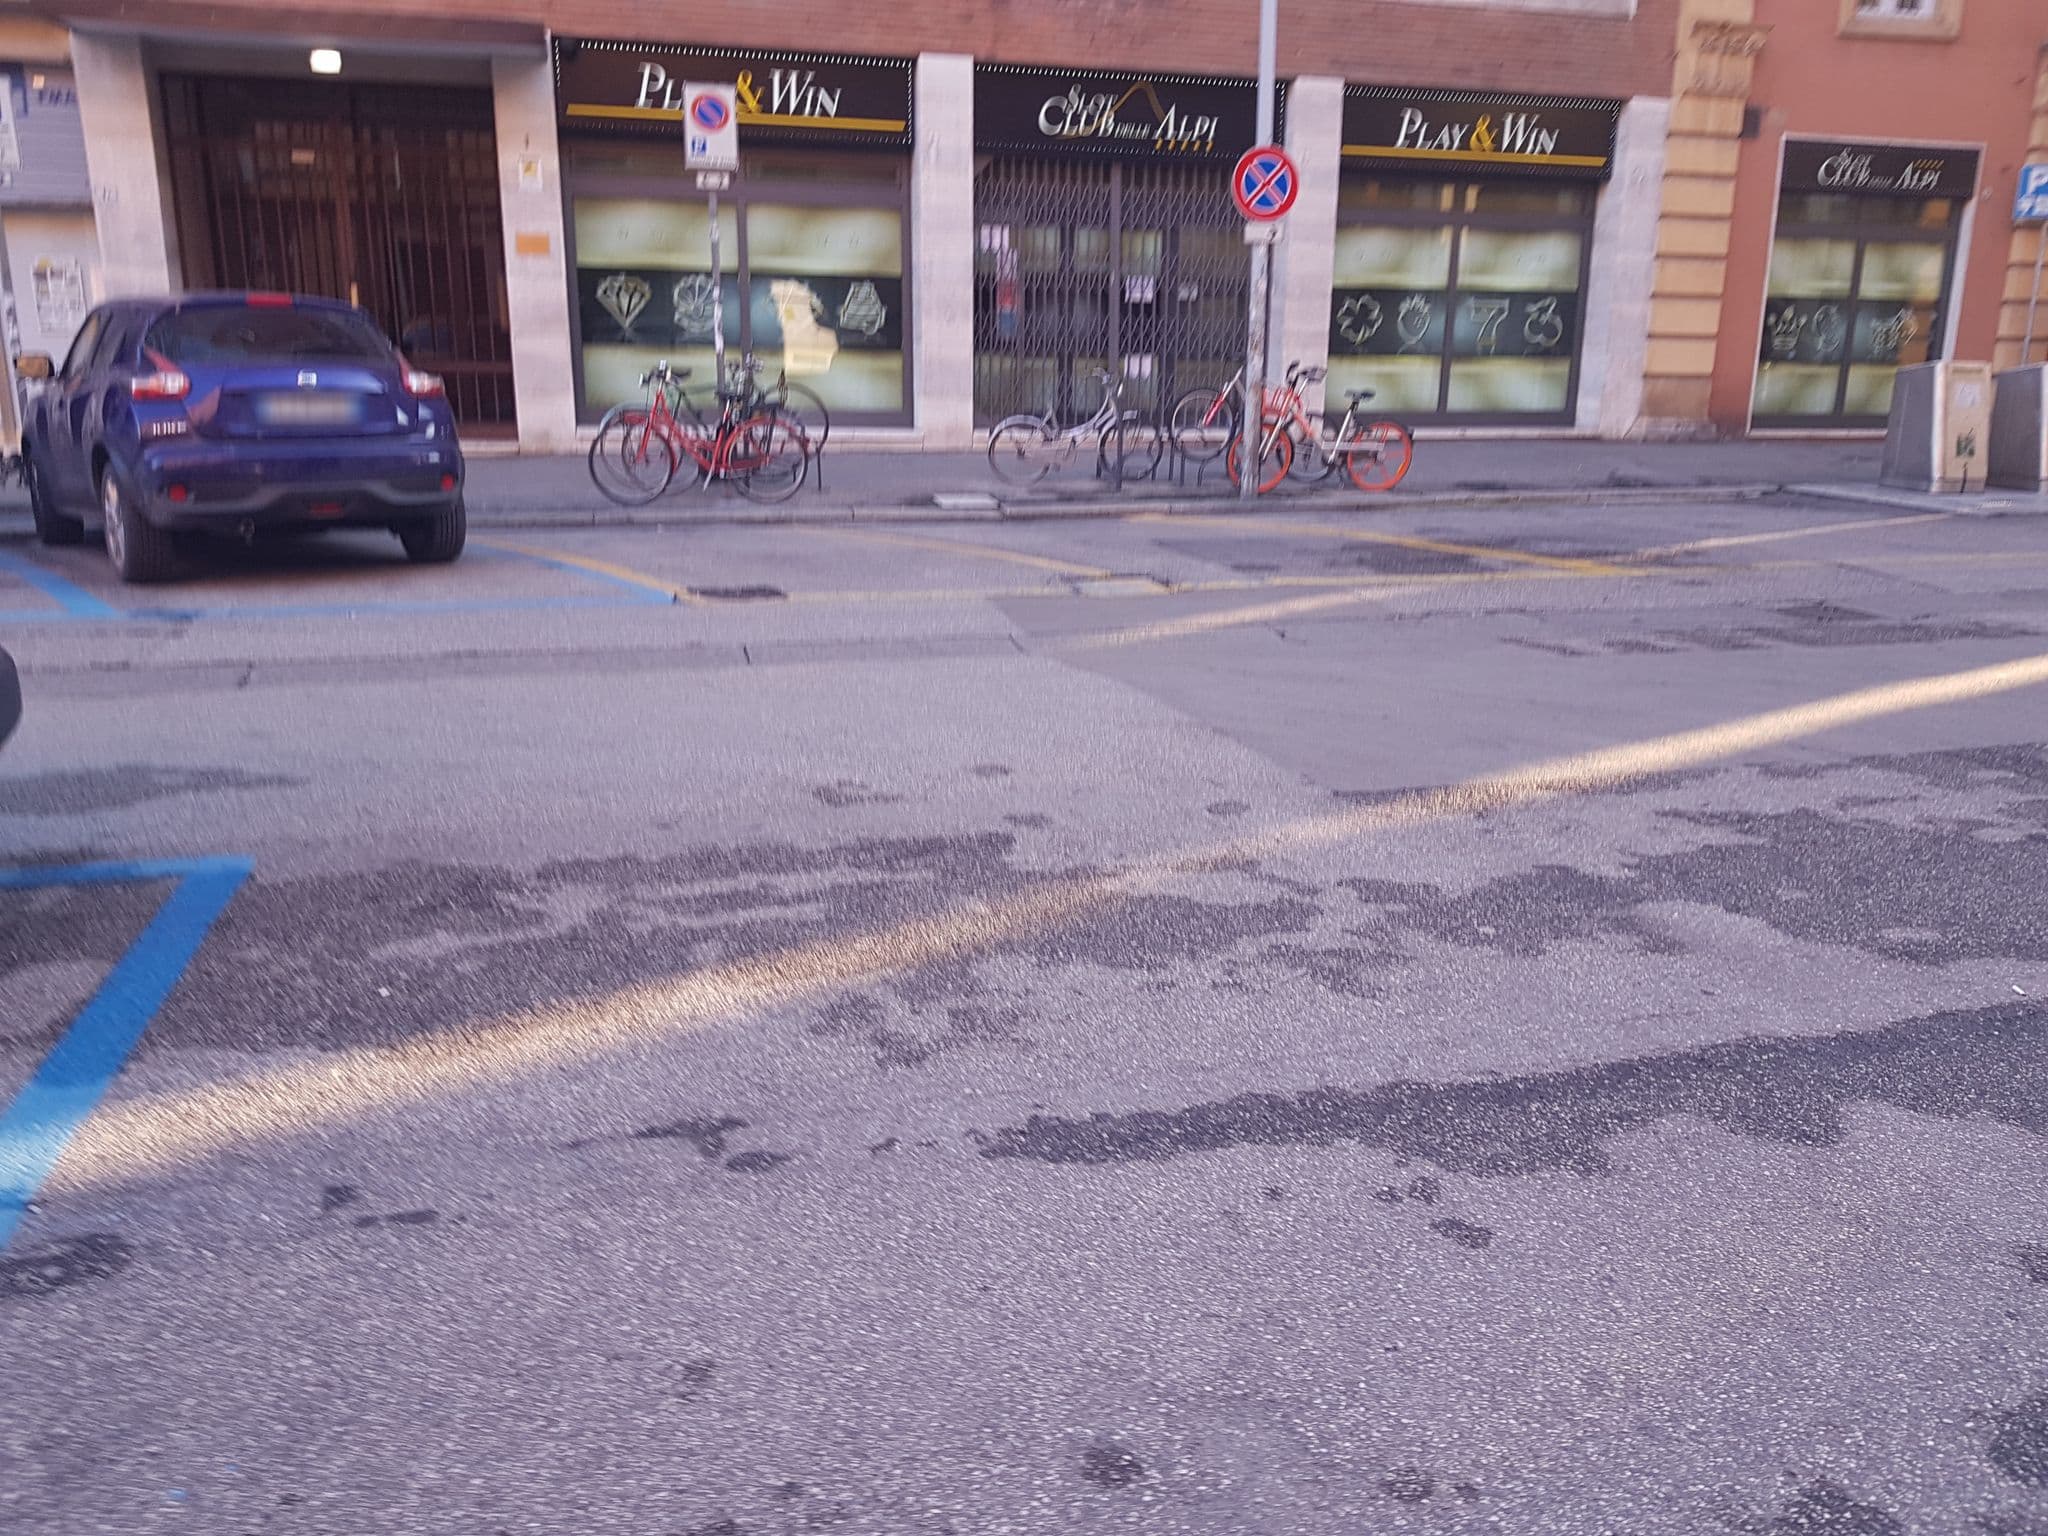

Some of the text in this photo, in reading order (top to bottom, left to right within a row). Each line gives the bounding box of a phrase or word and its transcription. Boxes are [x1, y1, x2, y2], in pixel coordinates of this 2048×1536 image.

[634, 60, 842, 118] PL & WIN
[1038, 95, 1115, 137] CLUB
[1153, 103, 1219, 142] ALPI
[1395, 107, 1559, 155] PLAY & WIN
